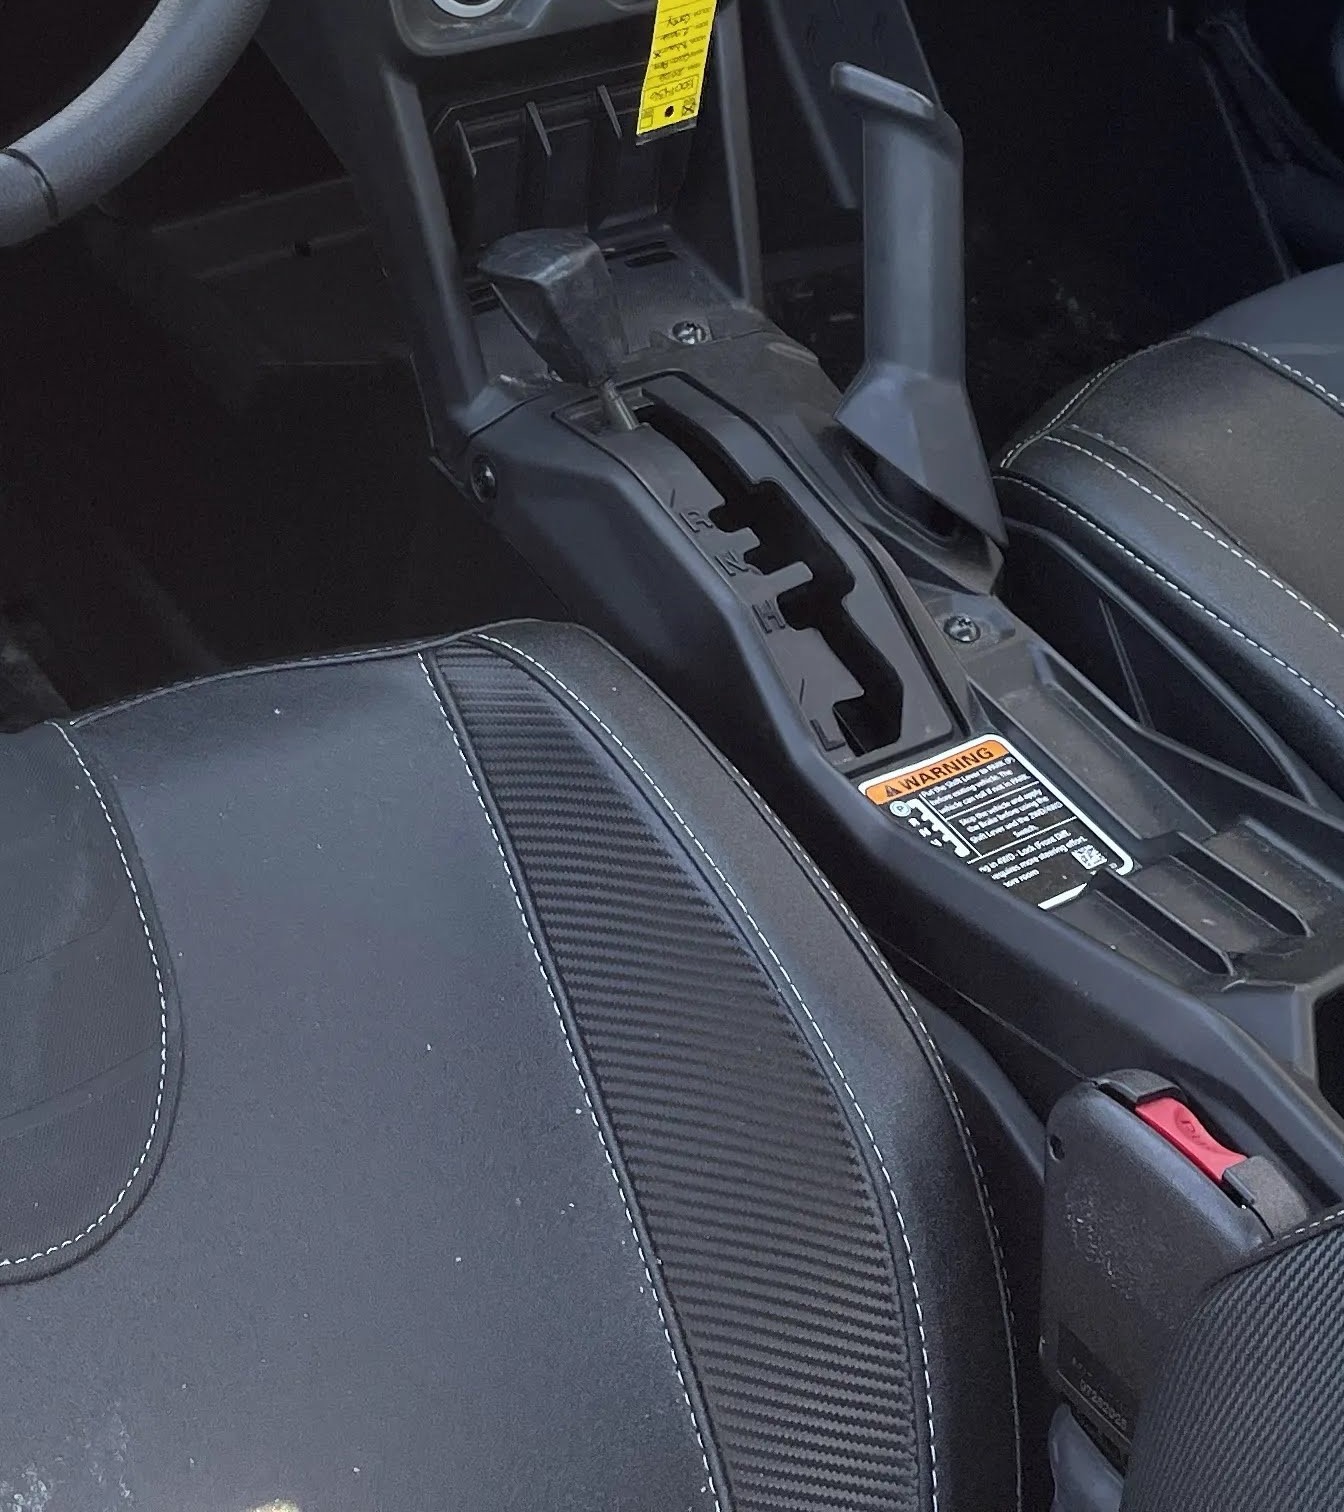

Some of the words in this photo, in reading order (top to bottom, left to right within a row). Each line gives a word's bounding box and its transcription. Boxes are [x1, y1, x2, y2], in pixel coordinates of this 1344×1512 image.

[752, 600, 786, 634] H
[811, 719, 846, 751] L
[898, 747, 994, 790] WARNING
